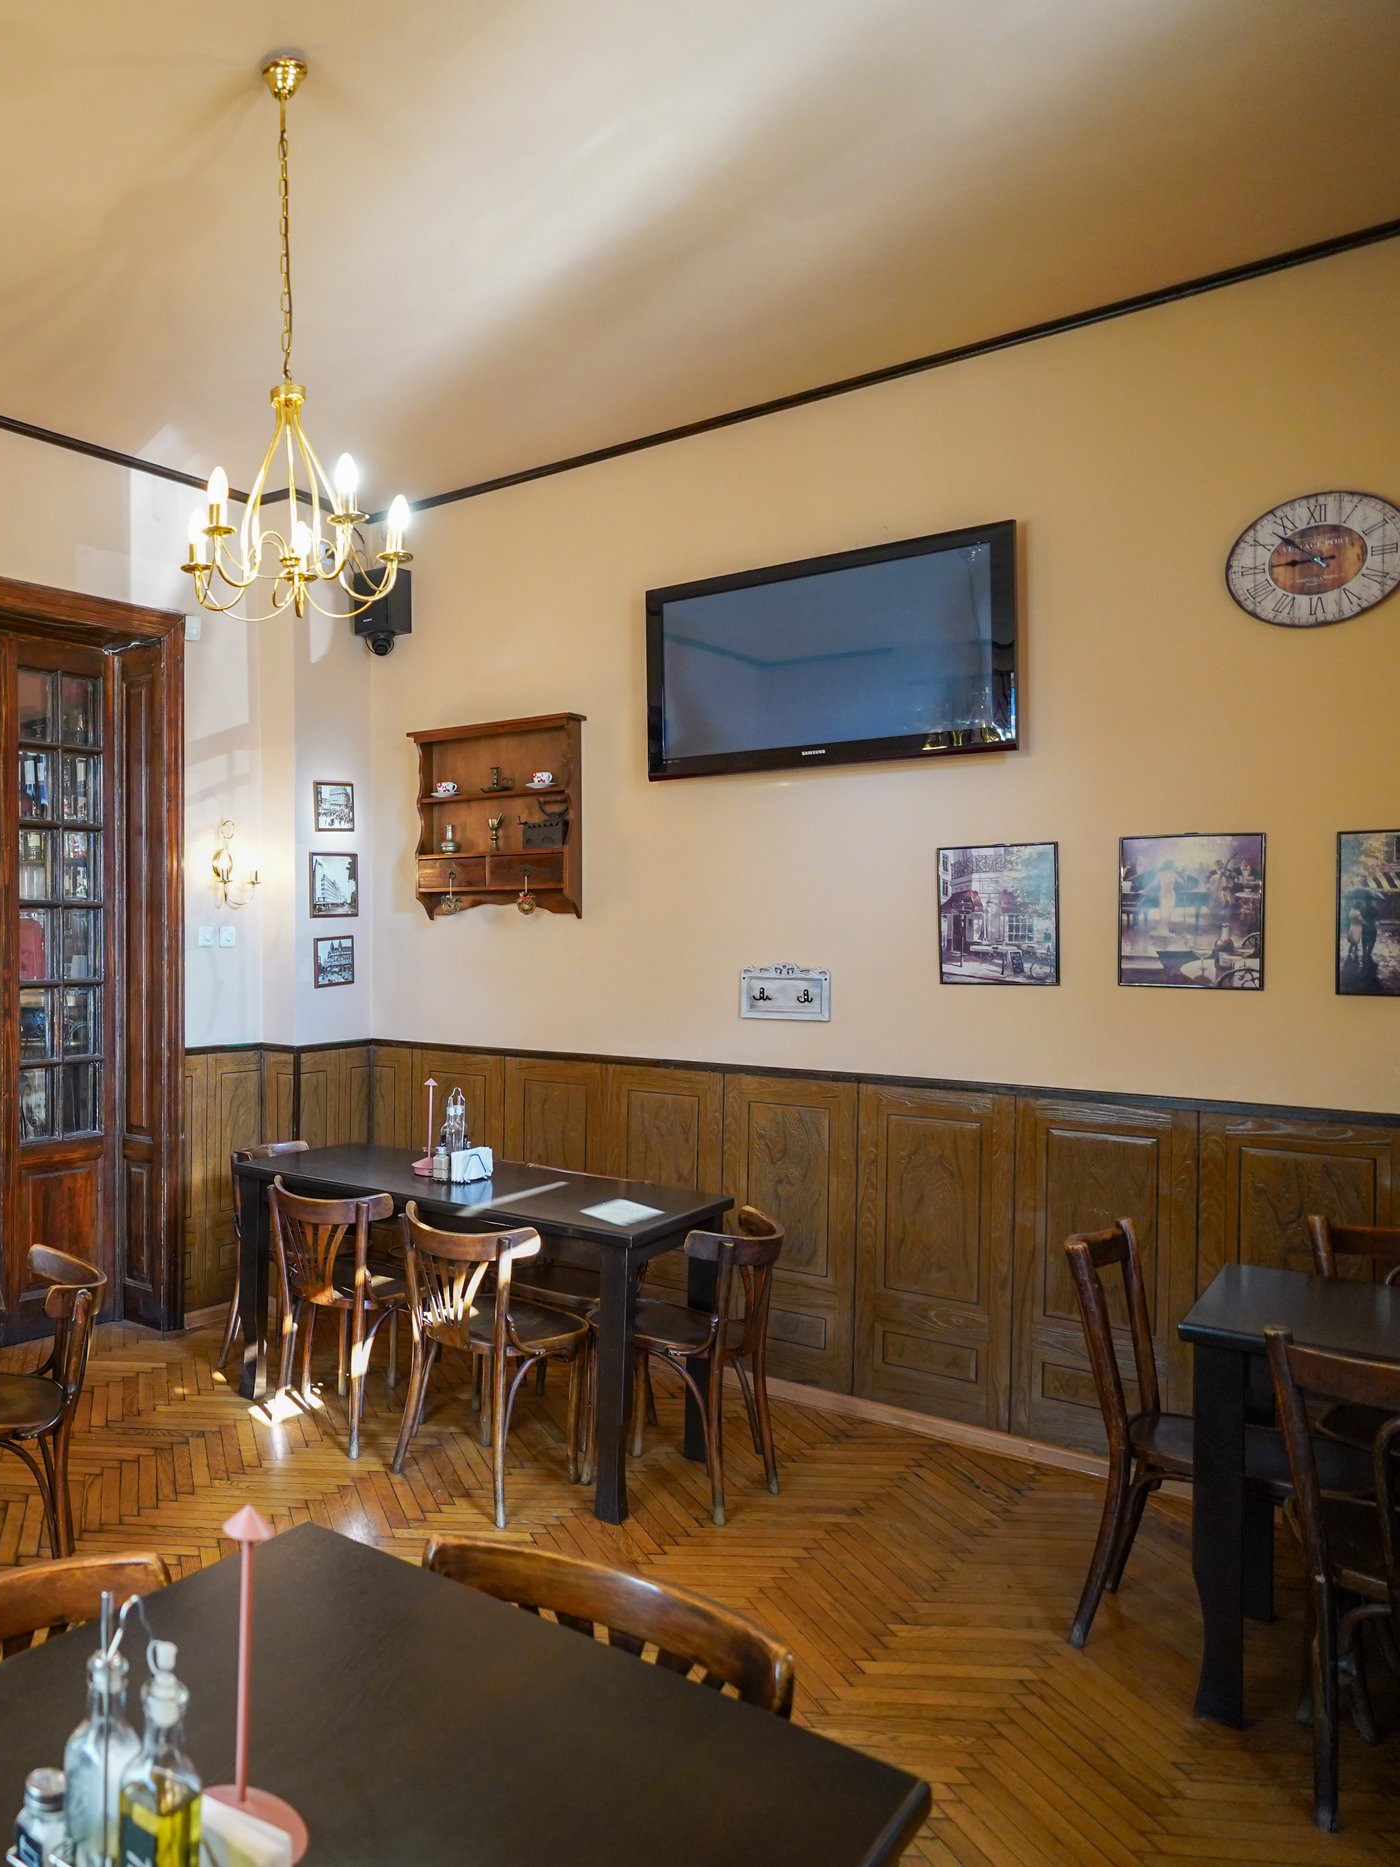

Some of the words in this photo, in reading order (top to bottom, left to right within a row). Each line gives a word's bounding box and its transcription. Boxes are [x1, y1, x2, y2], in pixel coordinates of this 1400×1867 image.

[1306, 503, 1328, 525] XII
[1273, 515, 1298, 535] XI
[1362, 518, 1389, 537] II
[1371, 542, 1399, 557] III
[1309, 596, 1326, 616] VI
